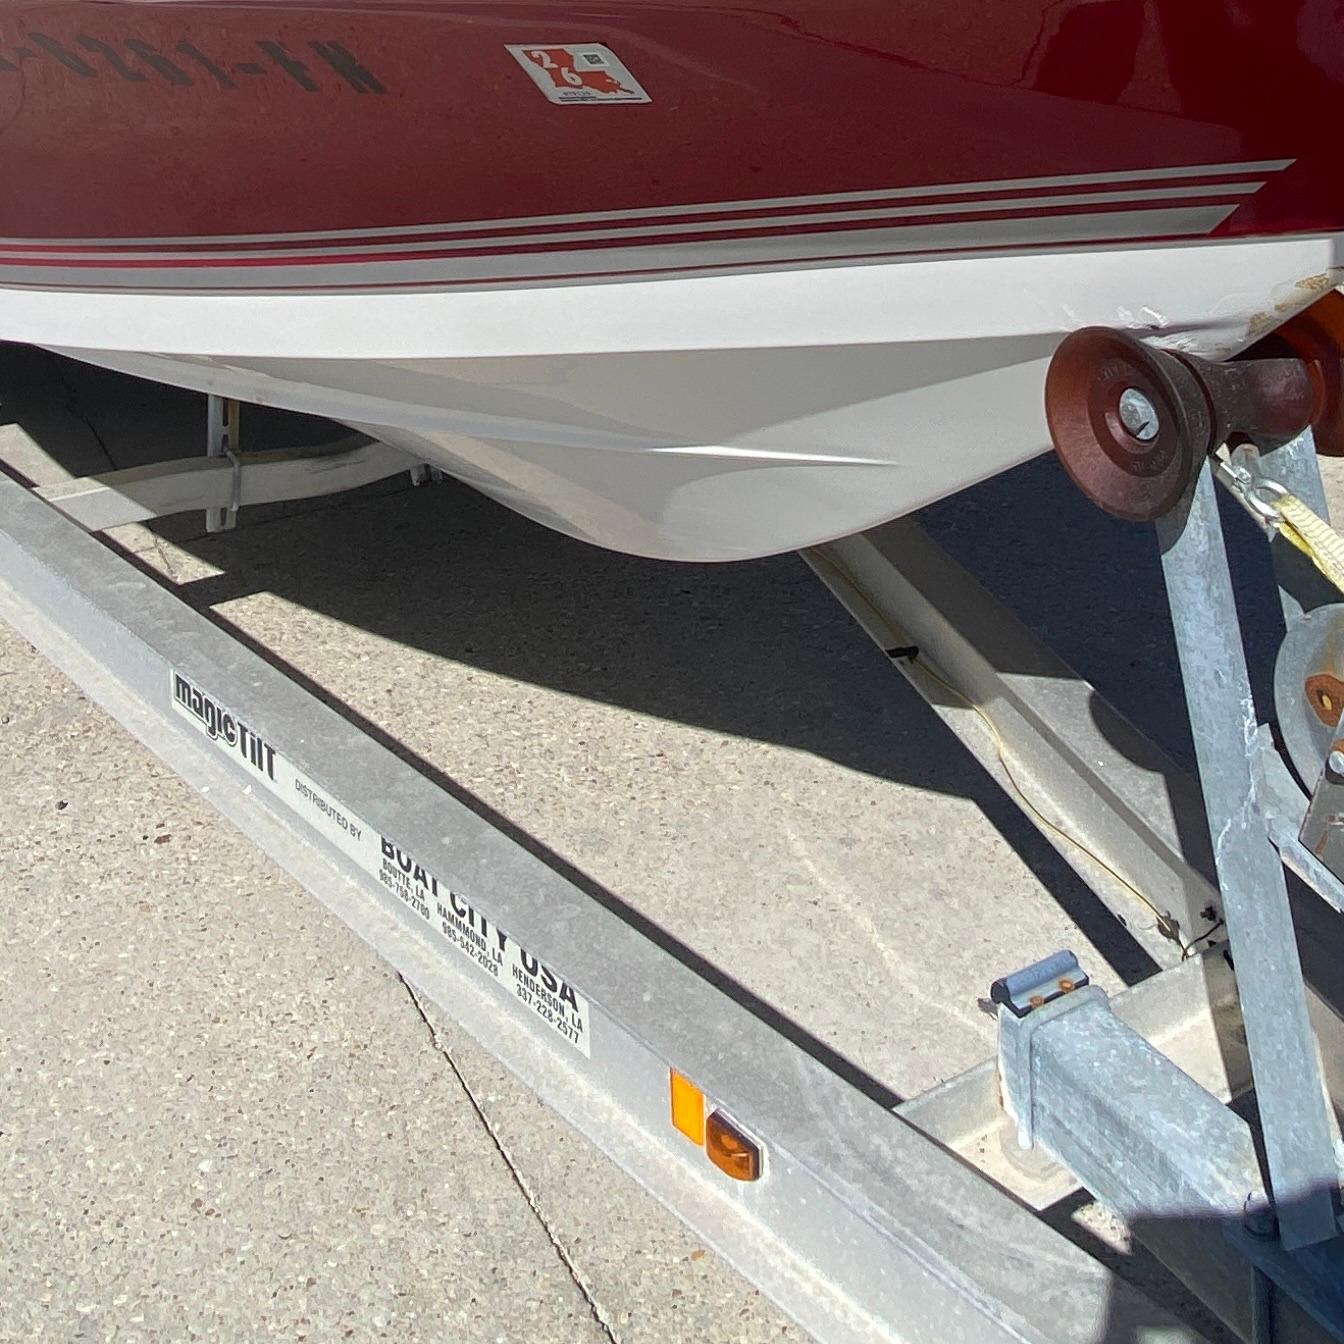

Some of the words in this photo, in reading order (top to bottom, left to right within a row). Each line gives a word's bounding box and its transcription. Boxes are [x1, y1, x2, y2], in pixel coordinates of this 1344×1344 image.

[295, 777, 349, 831] DISTRIBUTED
[349, 822, 363, 842] BY
[415, 884, 426, 902] LA
[492, 946, 504, 967] LA
[519, 946, 579, 1013] USA
[515, 983, 580, 1044] 337-228-2577
[571, 1012, 584, 1034] LA
